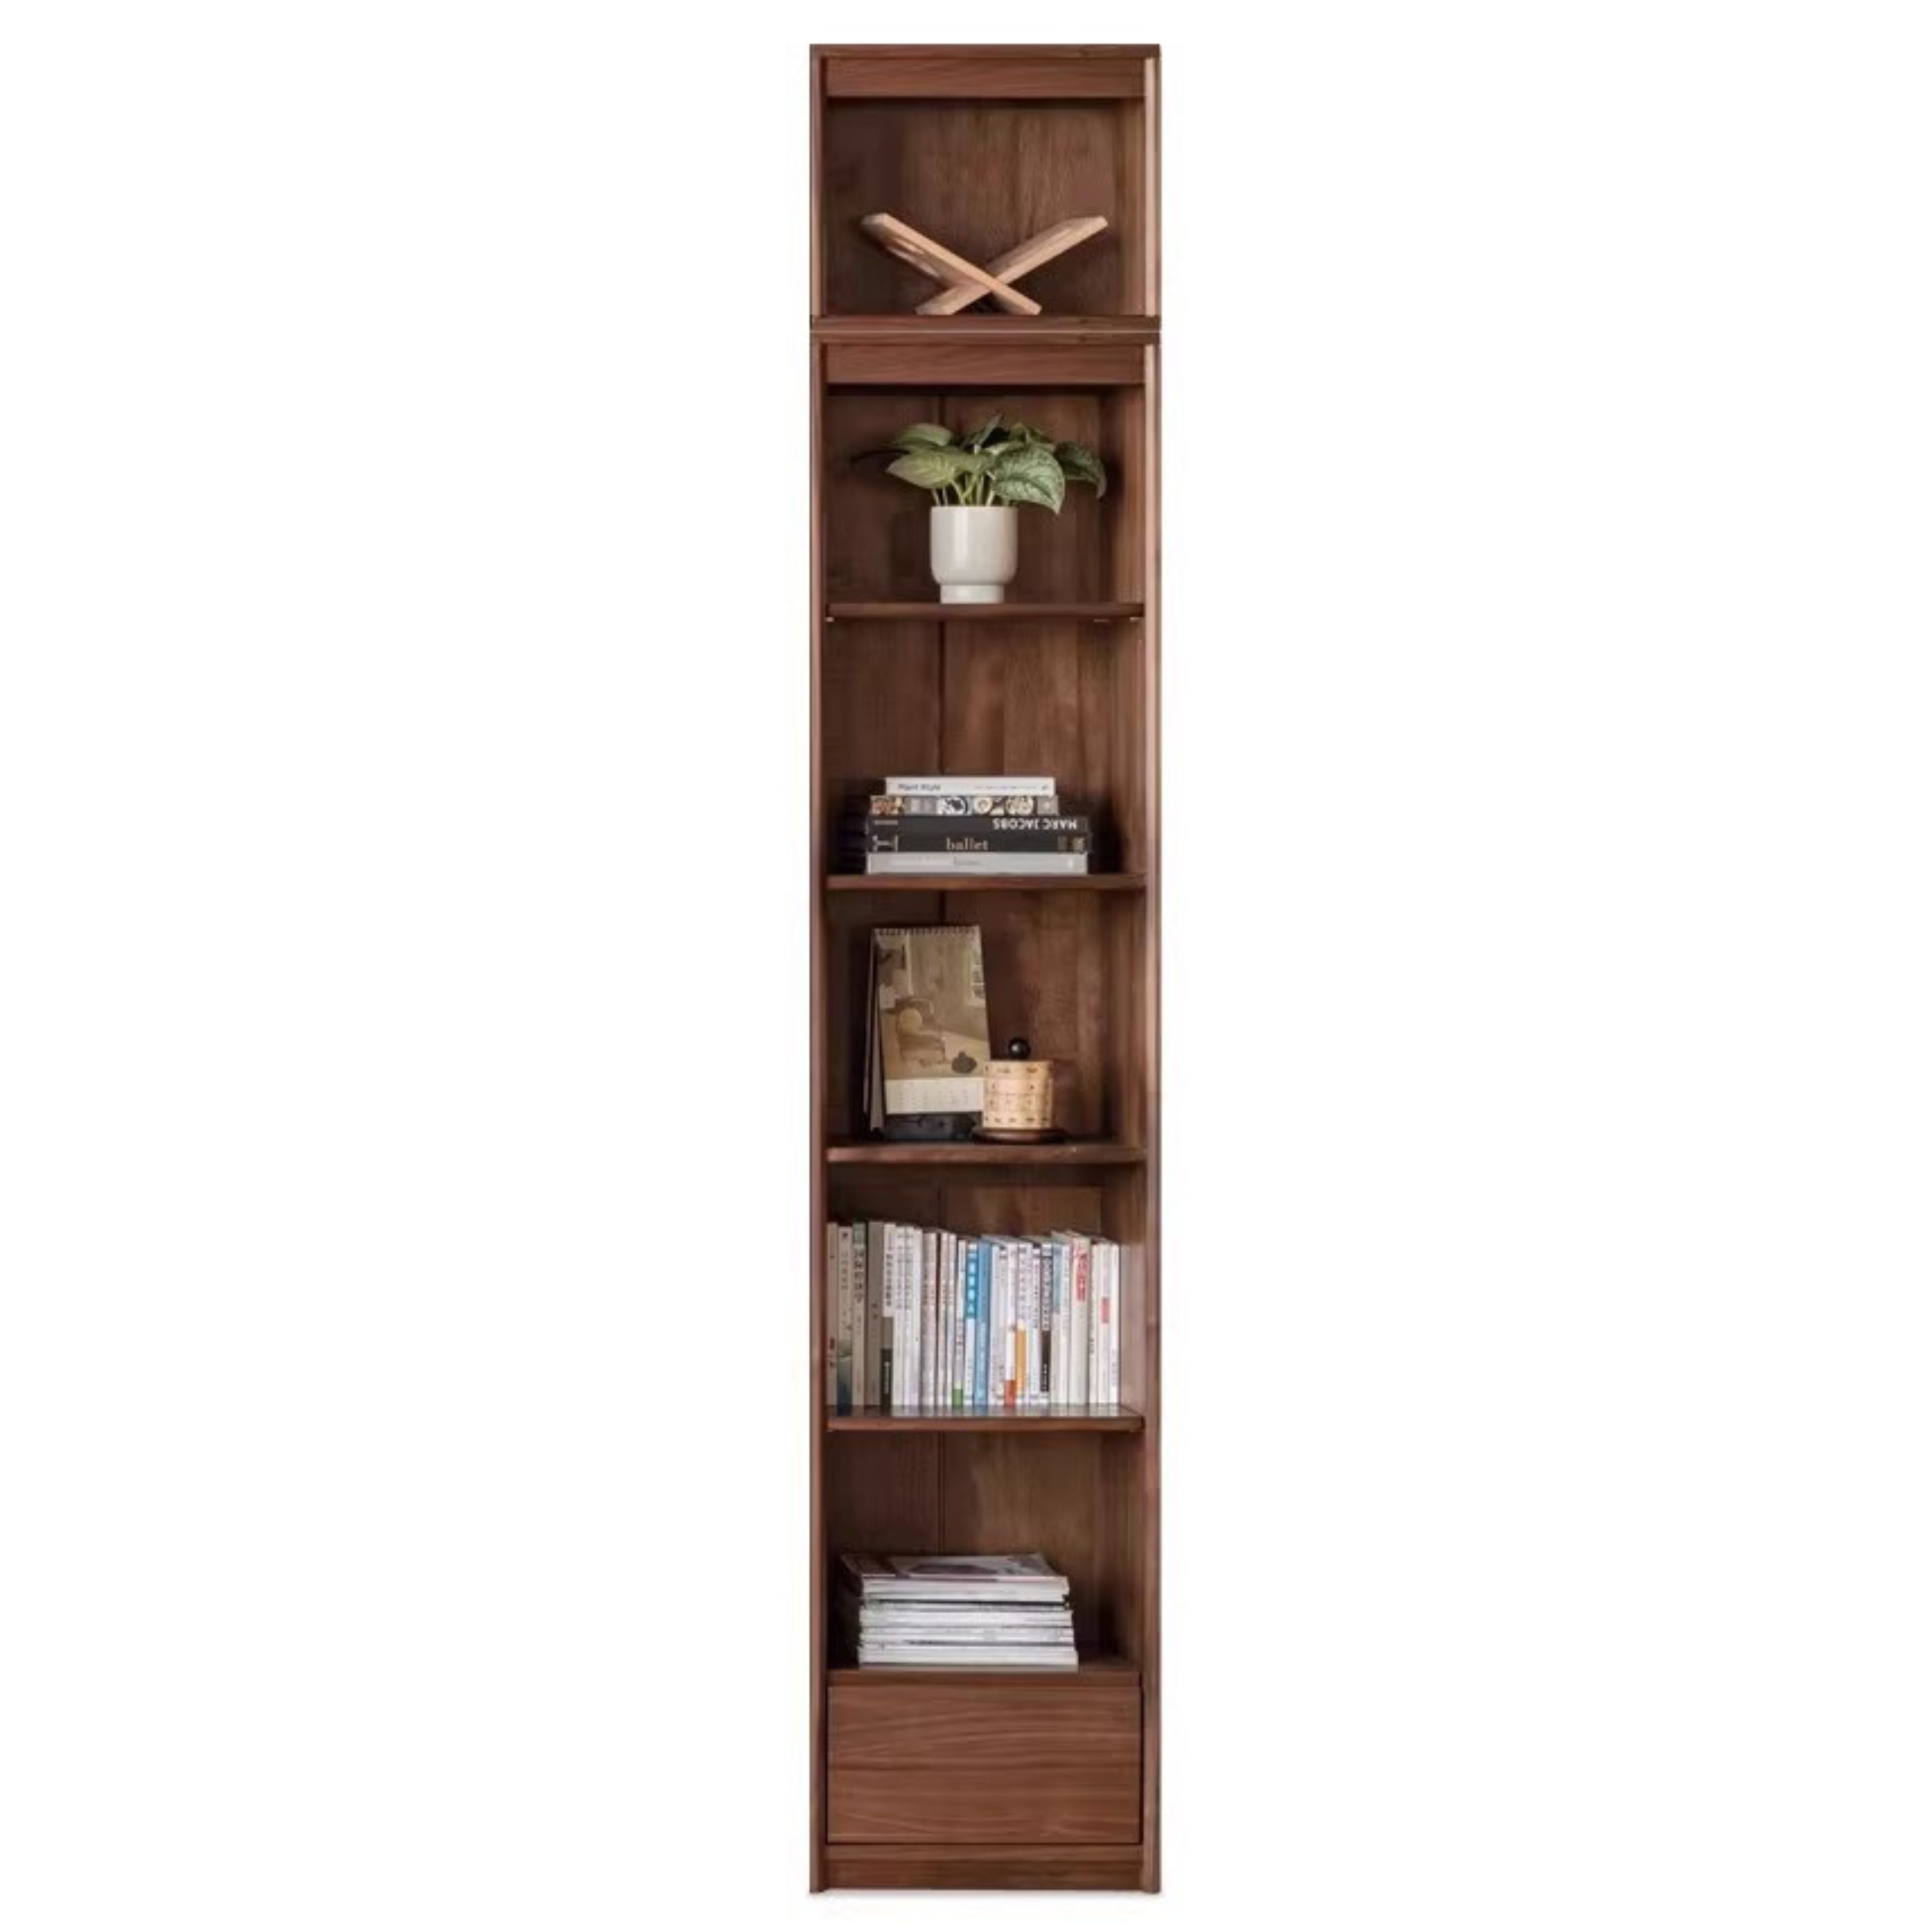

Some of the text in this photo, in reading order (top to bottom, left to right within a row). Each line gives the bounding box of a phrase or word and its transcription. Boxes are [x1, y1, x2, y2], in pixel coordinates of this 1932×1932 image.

[993, 817, 1077, 829] MARC JACOBS
[946, 837, 989, 851] ballet
